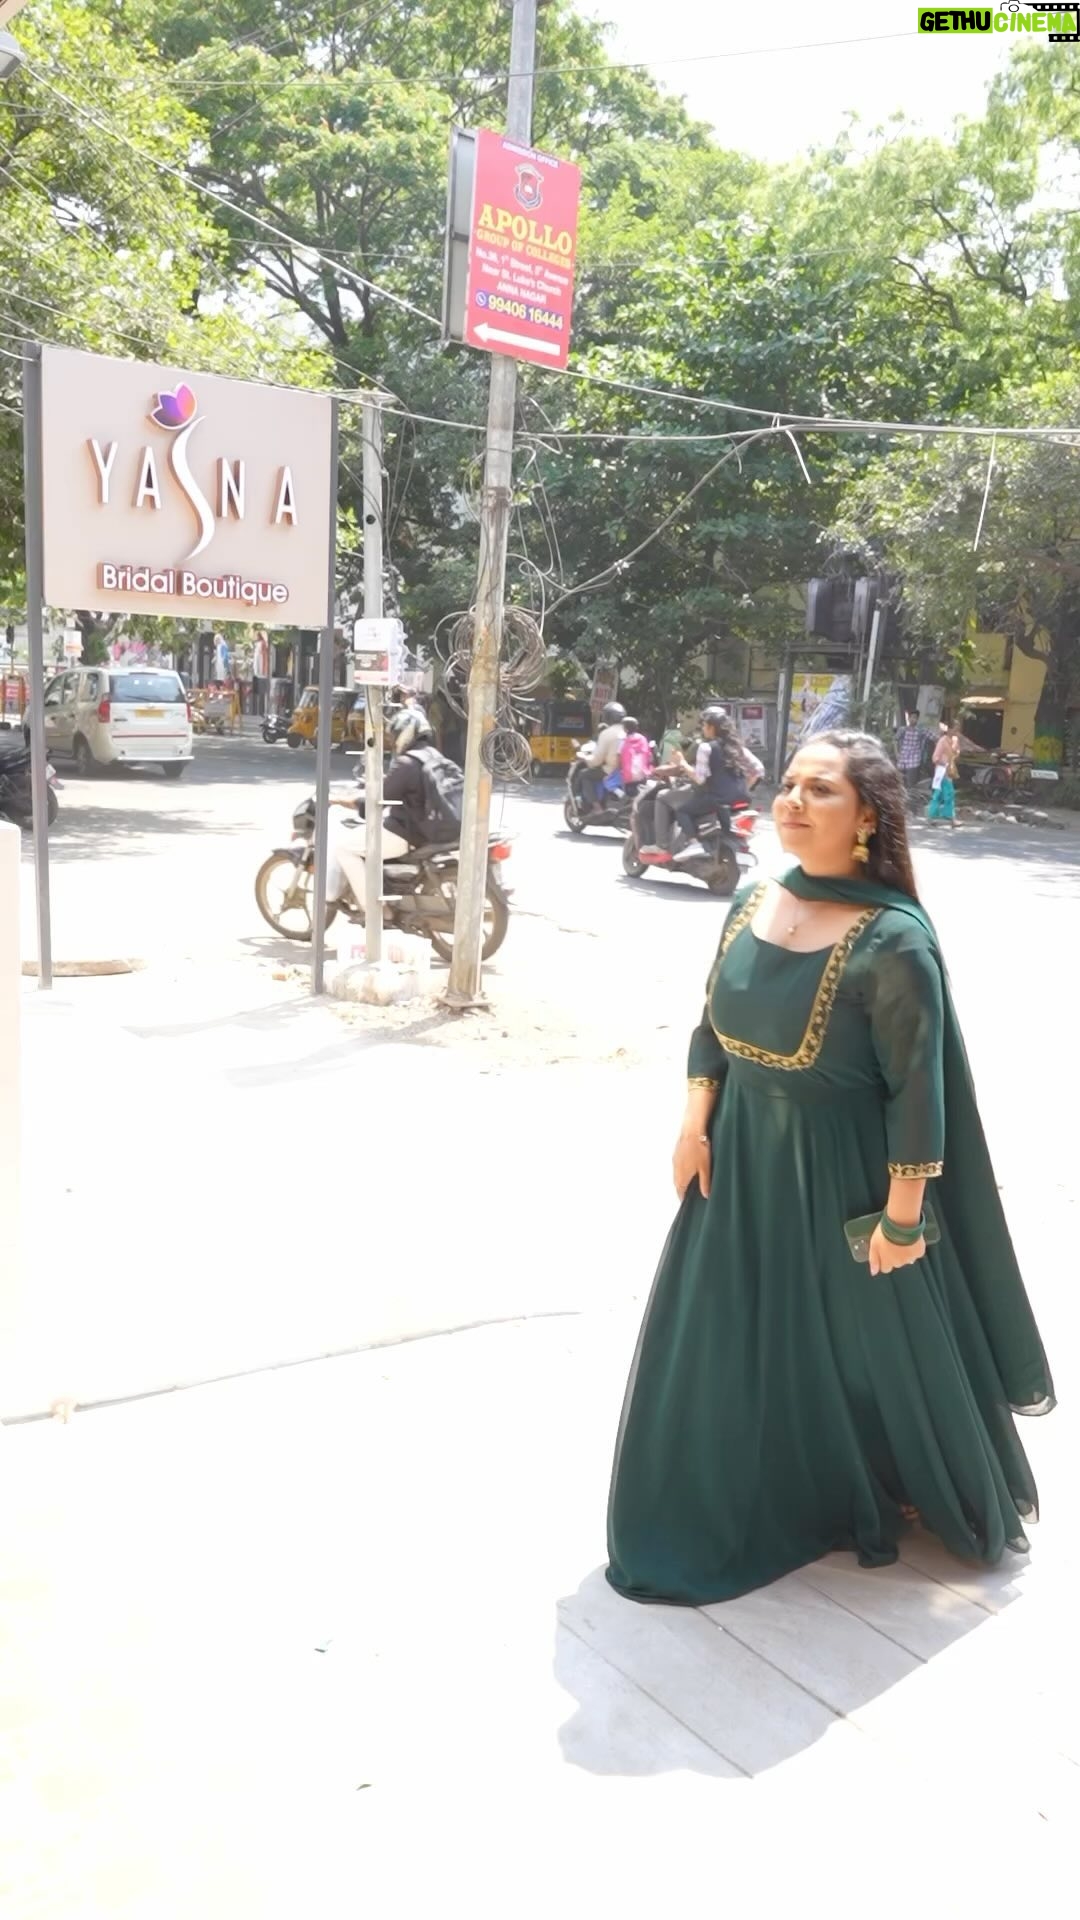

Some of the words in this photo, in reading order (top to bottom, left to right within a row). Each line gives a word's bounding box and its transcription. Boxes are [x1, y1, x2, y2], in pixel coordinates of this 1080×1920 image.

[476, 228, 510, 249] GROUP
[511, 239, 525, 253] OF
[525, 244, 571, 270] COLLEGES
[478, 203, 573, 256] APOLLO
[481, 262, 500, 277] Near
[536, 279, 562, 297] Church
[496, 281, 519, 296] ANNA
[519, 288, 547, 305] NAGAR
[487, 294, 527, 319] 99406
[528, 306, 564, 330] 16444
[87, 415, 298, 560] YASNA
[101, 563, 176, 595] Bridal
[181, 570, 289, 606] Boutique
